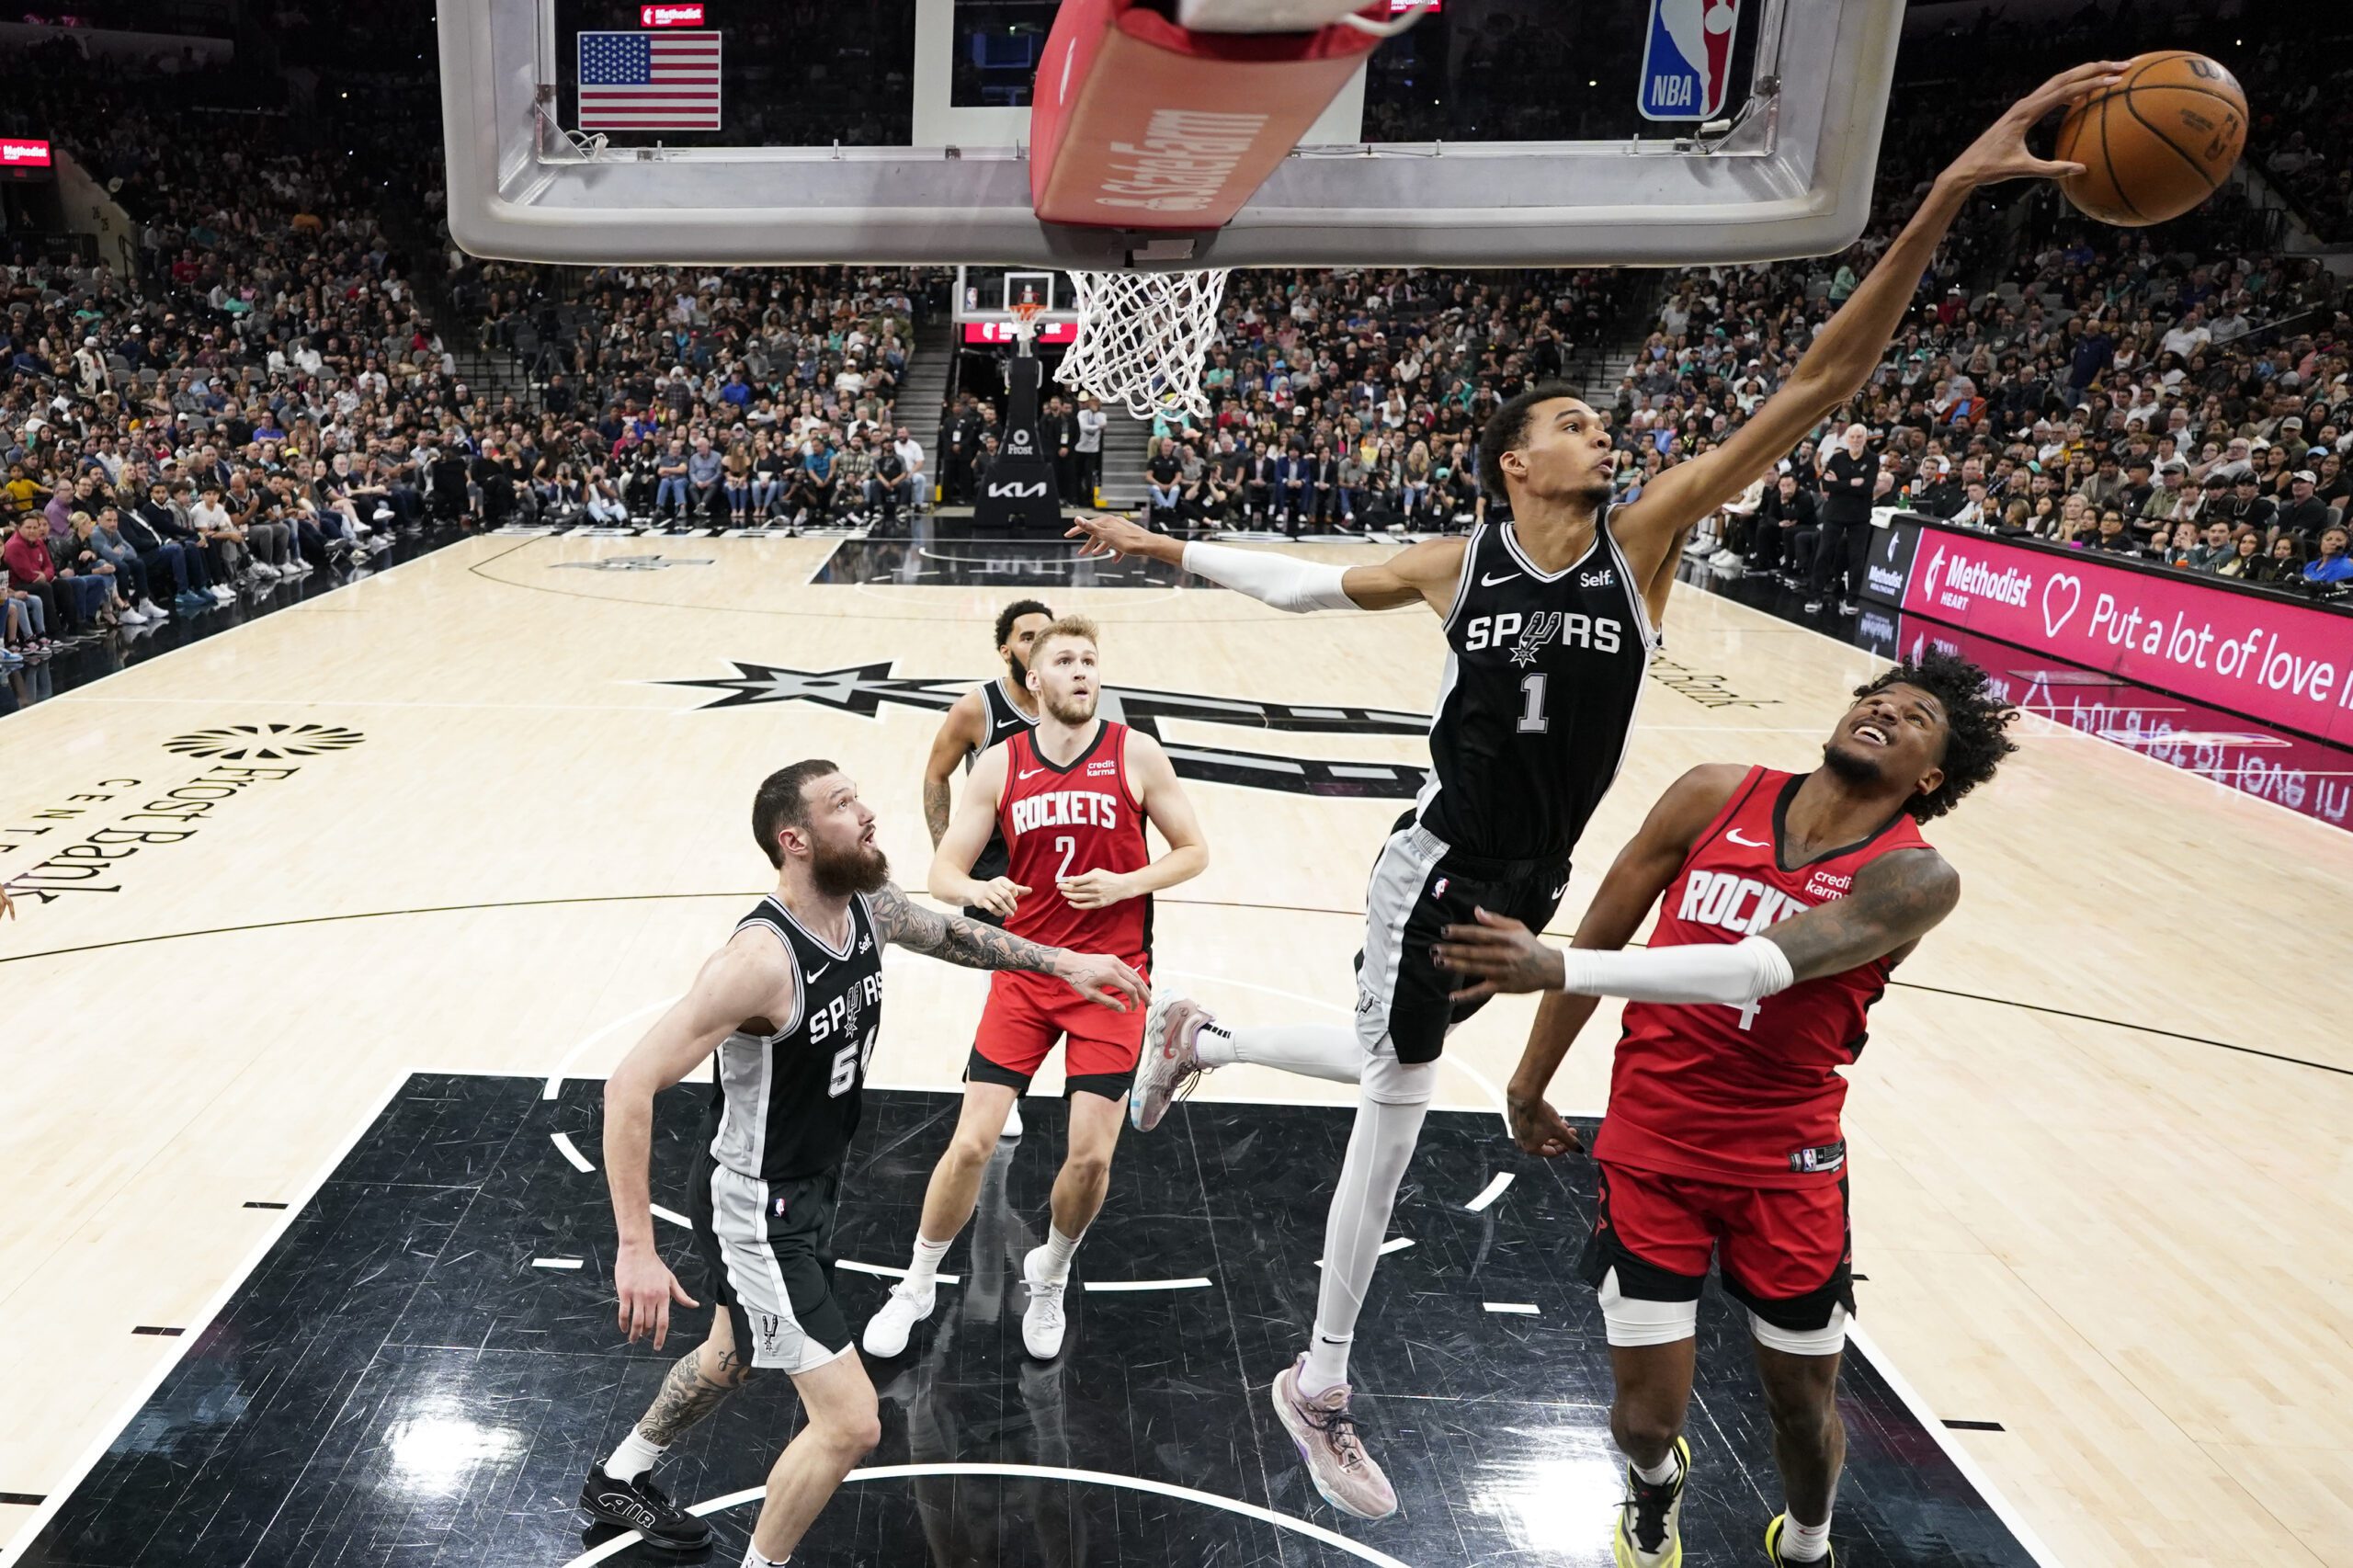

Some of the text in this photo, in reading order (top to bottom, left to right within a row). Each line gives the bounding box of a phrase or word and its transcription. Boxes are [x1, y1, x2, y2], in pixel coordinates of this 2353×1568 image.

[1651, 74, 1692, 107] NBA
[1007, 443, 1033, 456] Frost
[1940, 591, 1970, 611] HEART
[1945, 555, 2032, 608] Methodist
[1465, 611, 1621, 664] SPURS
[2088, 593, 2143, 649] Put
[2142, 619, 2163, 655] a
[2165, 610, 2215, 669] lot
[2215, 628, 2264, 679] of
[2256, 632, 2336, 701] love
[1516, 672, 1550, 734] 1
[1086, 767, 1116, 778] karma
[1087, 760, 1115, 770] credit
[0, 778, 142, 854] CENT
[1011, 790, 1118, 836] ROCKETS
[2, 766, 301, 904] Frost Bank
[1055, 835, 1076, 883] 2
[1804, 879, 1848, 901] karm
[1814, 870, 1853, 891] credi
[597, 1493, 656, 1529] AIR
